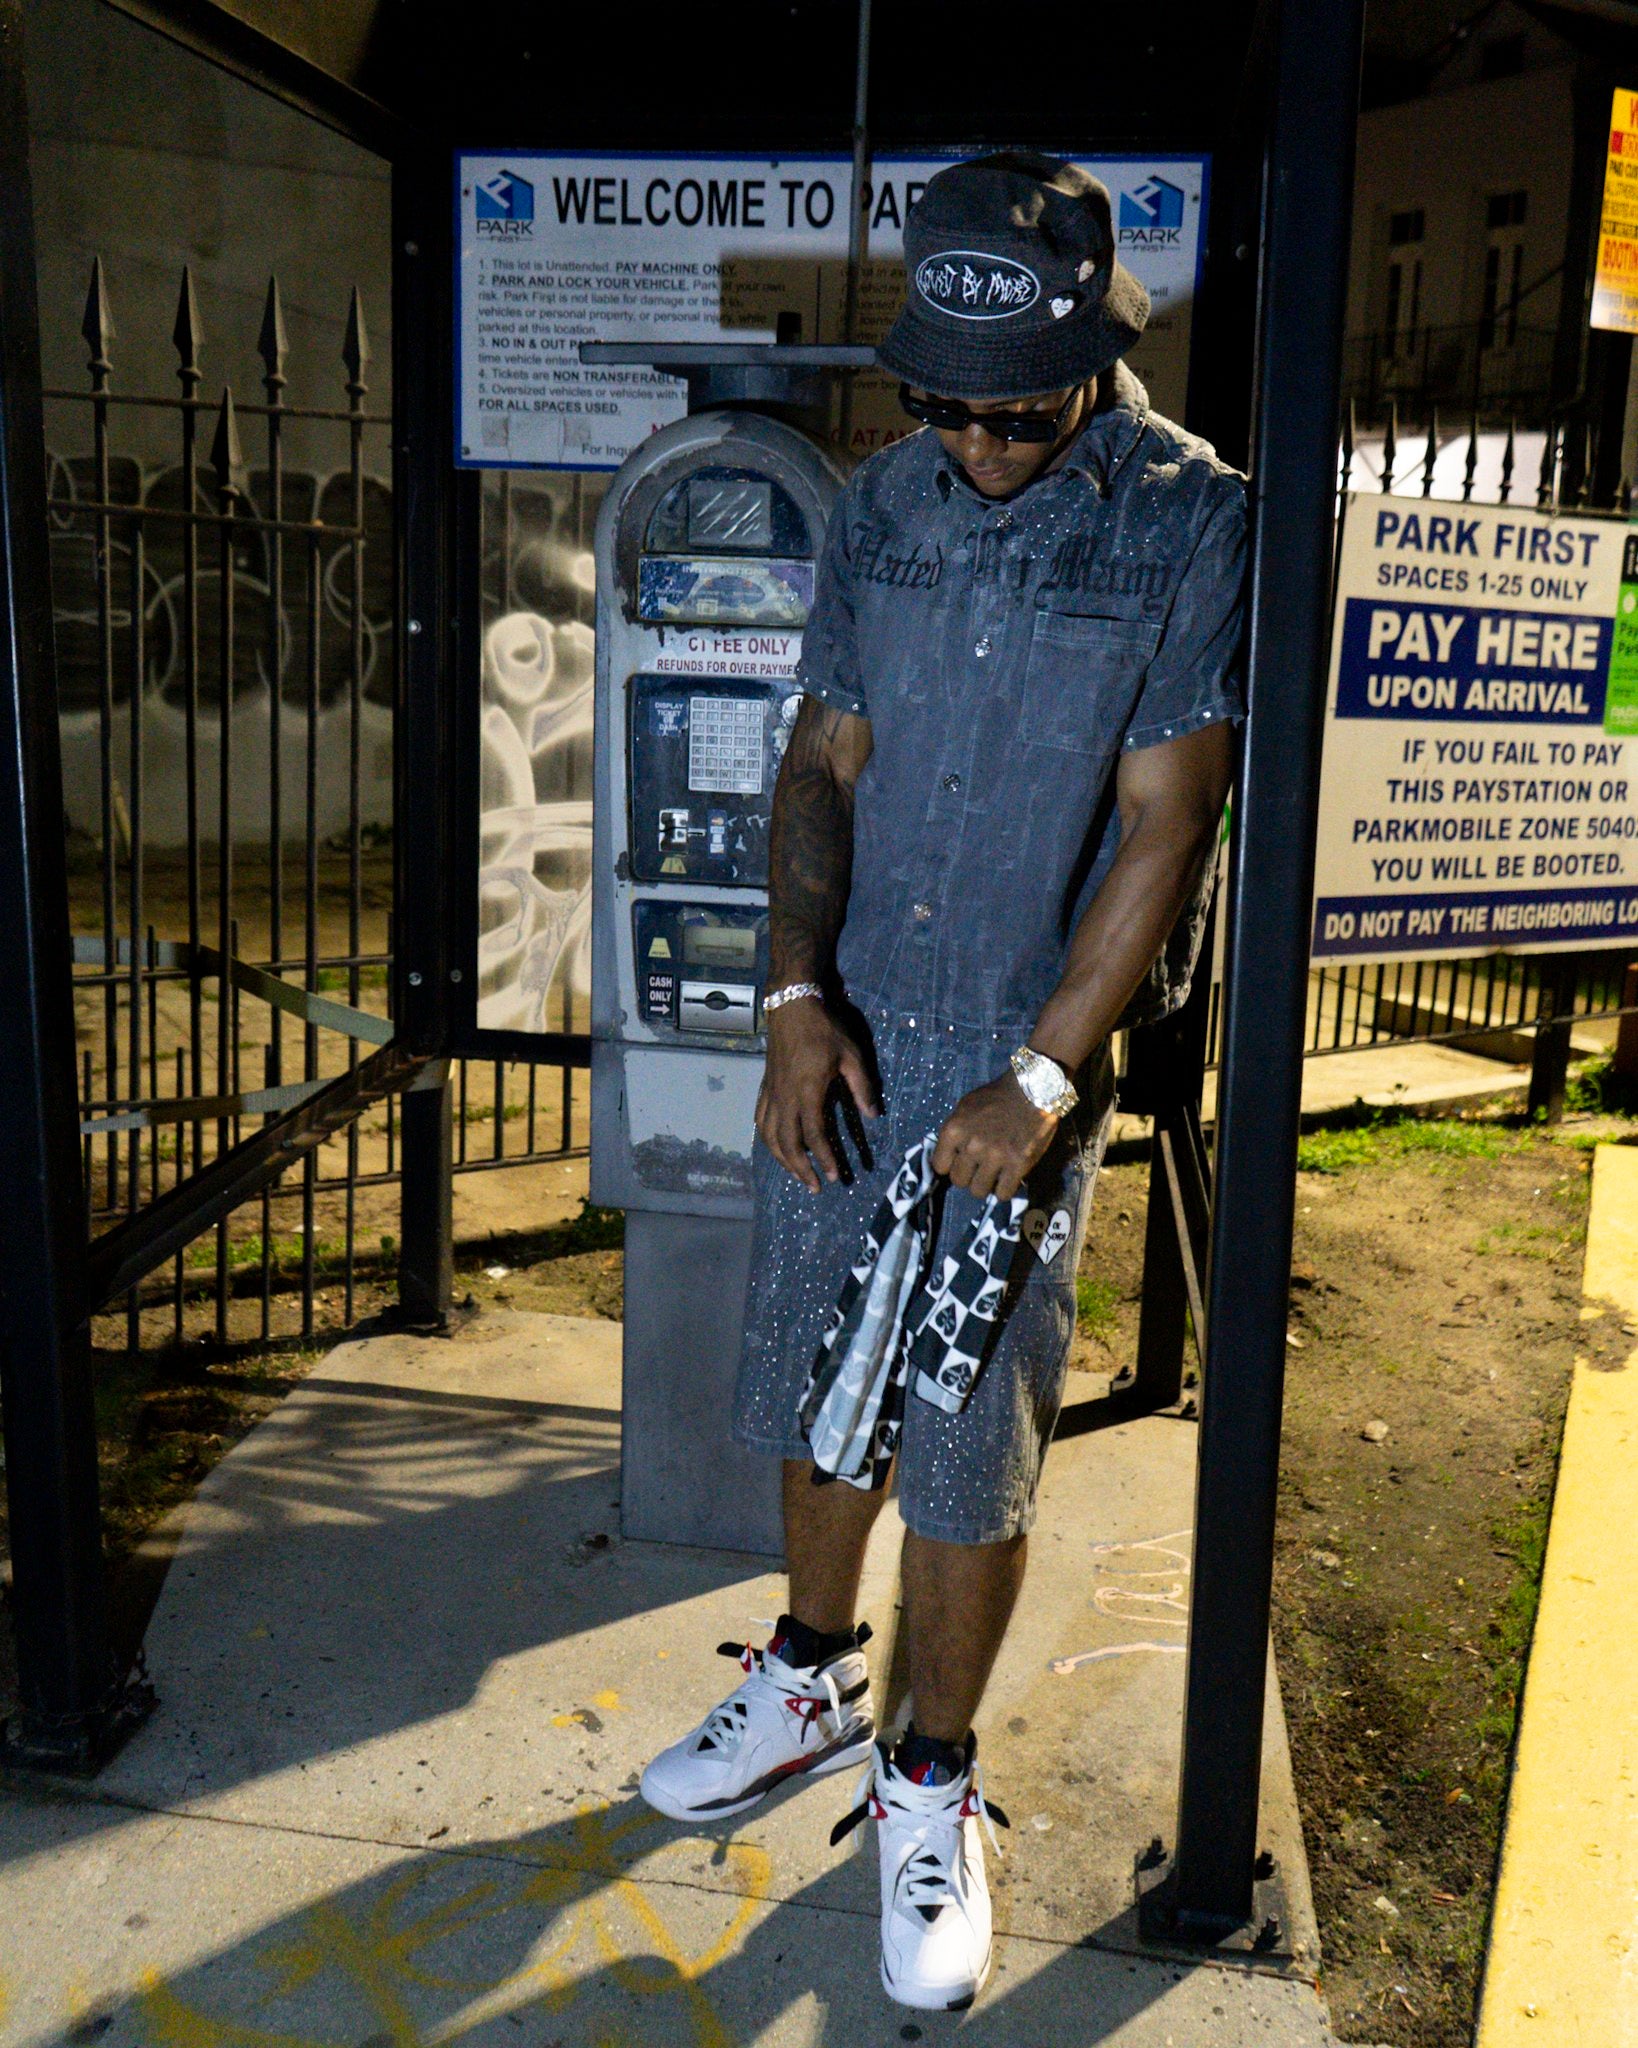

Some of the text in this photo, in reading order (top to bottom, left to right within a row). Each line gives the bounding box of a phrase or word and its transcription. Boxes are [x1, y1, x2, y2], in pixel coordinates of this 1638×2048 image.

[552, 176, 766, 227] WELCOME
[780, 179, 835, 227] TO
[476, 219, 533, 235] PARK
[490, 234, 521, 243] FIRST
[1118, 228, 1180, 244] PARK
[1133, 244, 1164, 252] FIRST
[492, 260, 515, 271] This
[517, 260, 530, 271] lot
[533, 261, 543, 271] is
[616, 262, 638, 273] PAY
[642, 263, 699, 274] MACHINE
[492, 276, 526, 287] PARK
[529, 276, 554, 287] AND
[558, 276, 592, 288] LOCK
[595, 277, 629, 288] YOUR
[693, 280, 718, 291] Park
[962, 264, 984, 305] BY
[985, 271, 1032, 306] MORE
[504, 291, 528, 302] Park
[532, 292, 556, 303] First
[559, 292, 567, 303] is
[571, 293, 588, 304] not
[591, 293, 620, 304] liable
[623, 293, 637, 304] for
[640, 295, 684, 308] damage
[687, 297, 698, 305] or
[479, 306, 522, 318] vehicles
[524, 309, 536, 318] or
[539, 308, 586, 321] personal
[639, 312, 651, 321] or
[654, 311, 700, 323] personal
[478, 322, 516, 336] parked
[518, 324, 528, 334] at
[532, 323, 551, 334] this
[492, 338, 510, 349] NO
[513, 338, 525, 349] IN
[529, 339, 538, 349] &
[541, 339, 565, 350] OUT
[478, 353, 578, 366] time vehicle enters
[492, 369, 529, 380] Tickets
[532, 372, 549, 380] are
[553, 370, 580, 382] NON
[492, 385, 546, 396] Oversized
[549, 386, 592, 397] vehicles
[595, 389, 606, 398] or
[610, 388, 653, 399] vehicles
[656, 388, 678, 399] with
[479, 399, 503, 410] FOR
[507, 399, 529, 411] ALL
[533, 400, 582, 412] SPACES
[582, 443, 602, 456] For
[1374, 510, 1481, 558] PARK
[1493, 524, 1600, 567] FIRST
[850, 521, 944, 590] Hated
[1034, 531, 1173, 616] Many
[1377, 563, 1588, 602] SPACES 1-25 ONLY
[713, 637, 743, 653] FEE
[748, 637, 790, 656] ONLY
[1367, 609, 1601, 671] PAY HERE
[656, 658, 704, 672] REFUNDS
[706, 661, 727, 673] FOR
[729, 662, 757, 675] OVER
[1366, 673, 1590, 715] UPON ARRIVAL
[654, 702, 684, 710] DISPLAY
[656, 709, 682, 717] TICKET
[659, 723, 679, 731] DASH
[1402, 740, 1624, 766] IF YOU FAIL TO PAY
[1387, 779, 1629, 803] THIS PAYSTATION OR
[1352, 818, 1511, 843] PARKMOBILE
[1518, 818, 1579, 840] ZONE
[1371, 853, 1625, 882] YOU WILL BE BOOTED.
[1324, 913, 1356, 941] DO
[1359, 910, 1404, 939] NOT
[1407, 907, 1447, 937] PAY
[1449, 905, 1490, 933] THE
[1491, 898, 1616, 932] NEIGHBORING
[649, 975, 673, 988] CASH
[649, 989, 672, 1002] ONLY
